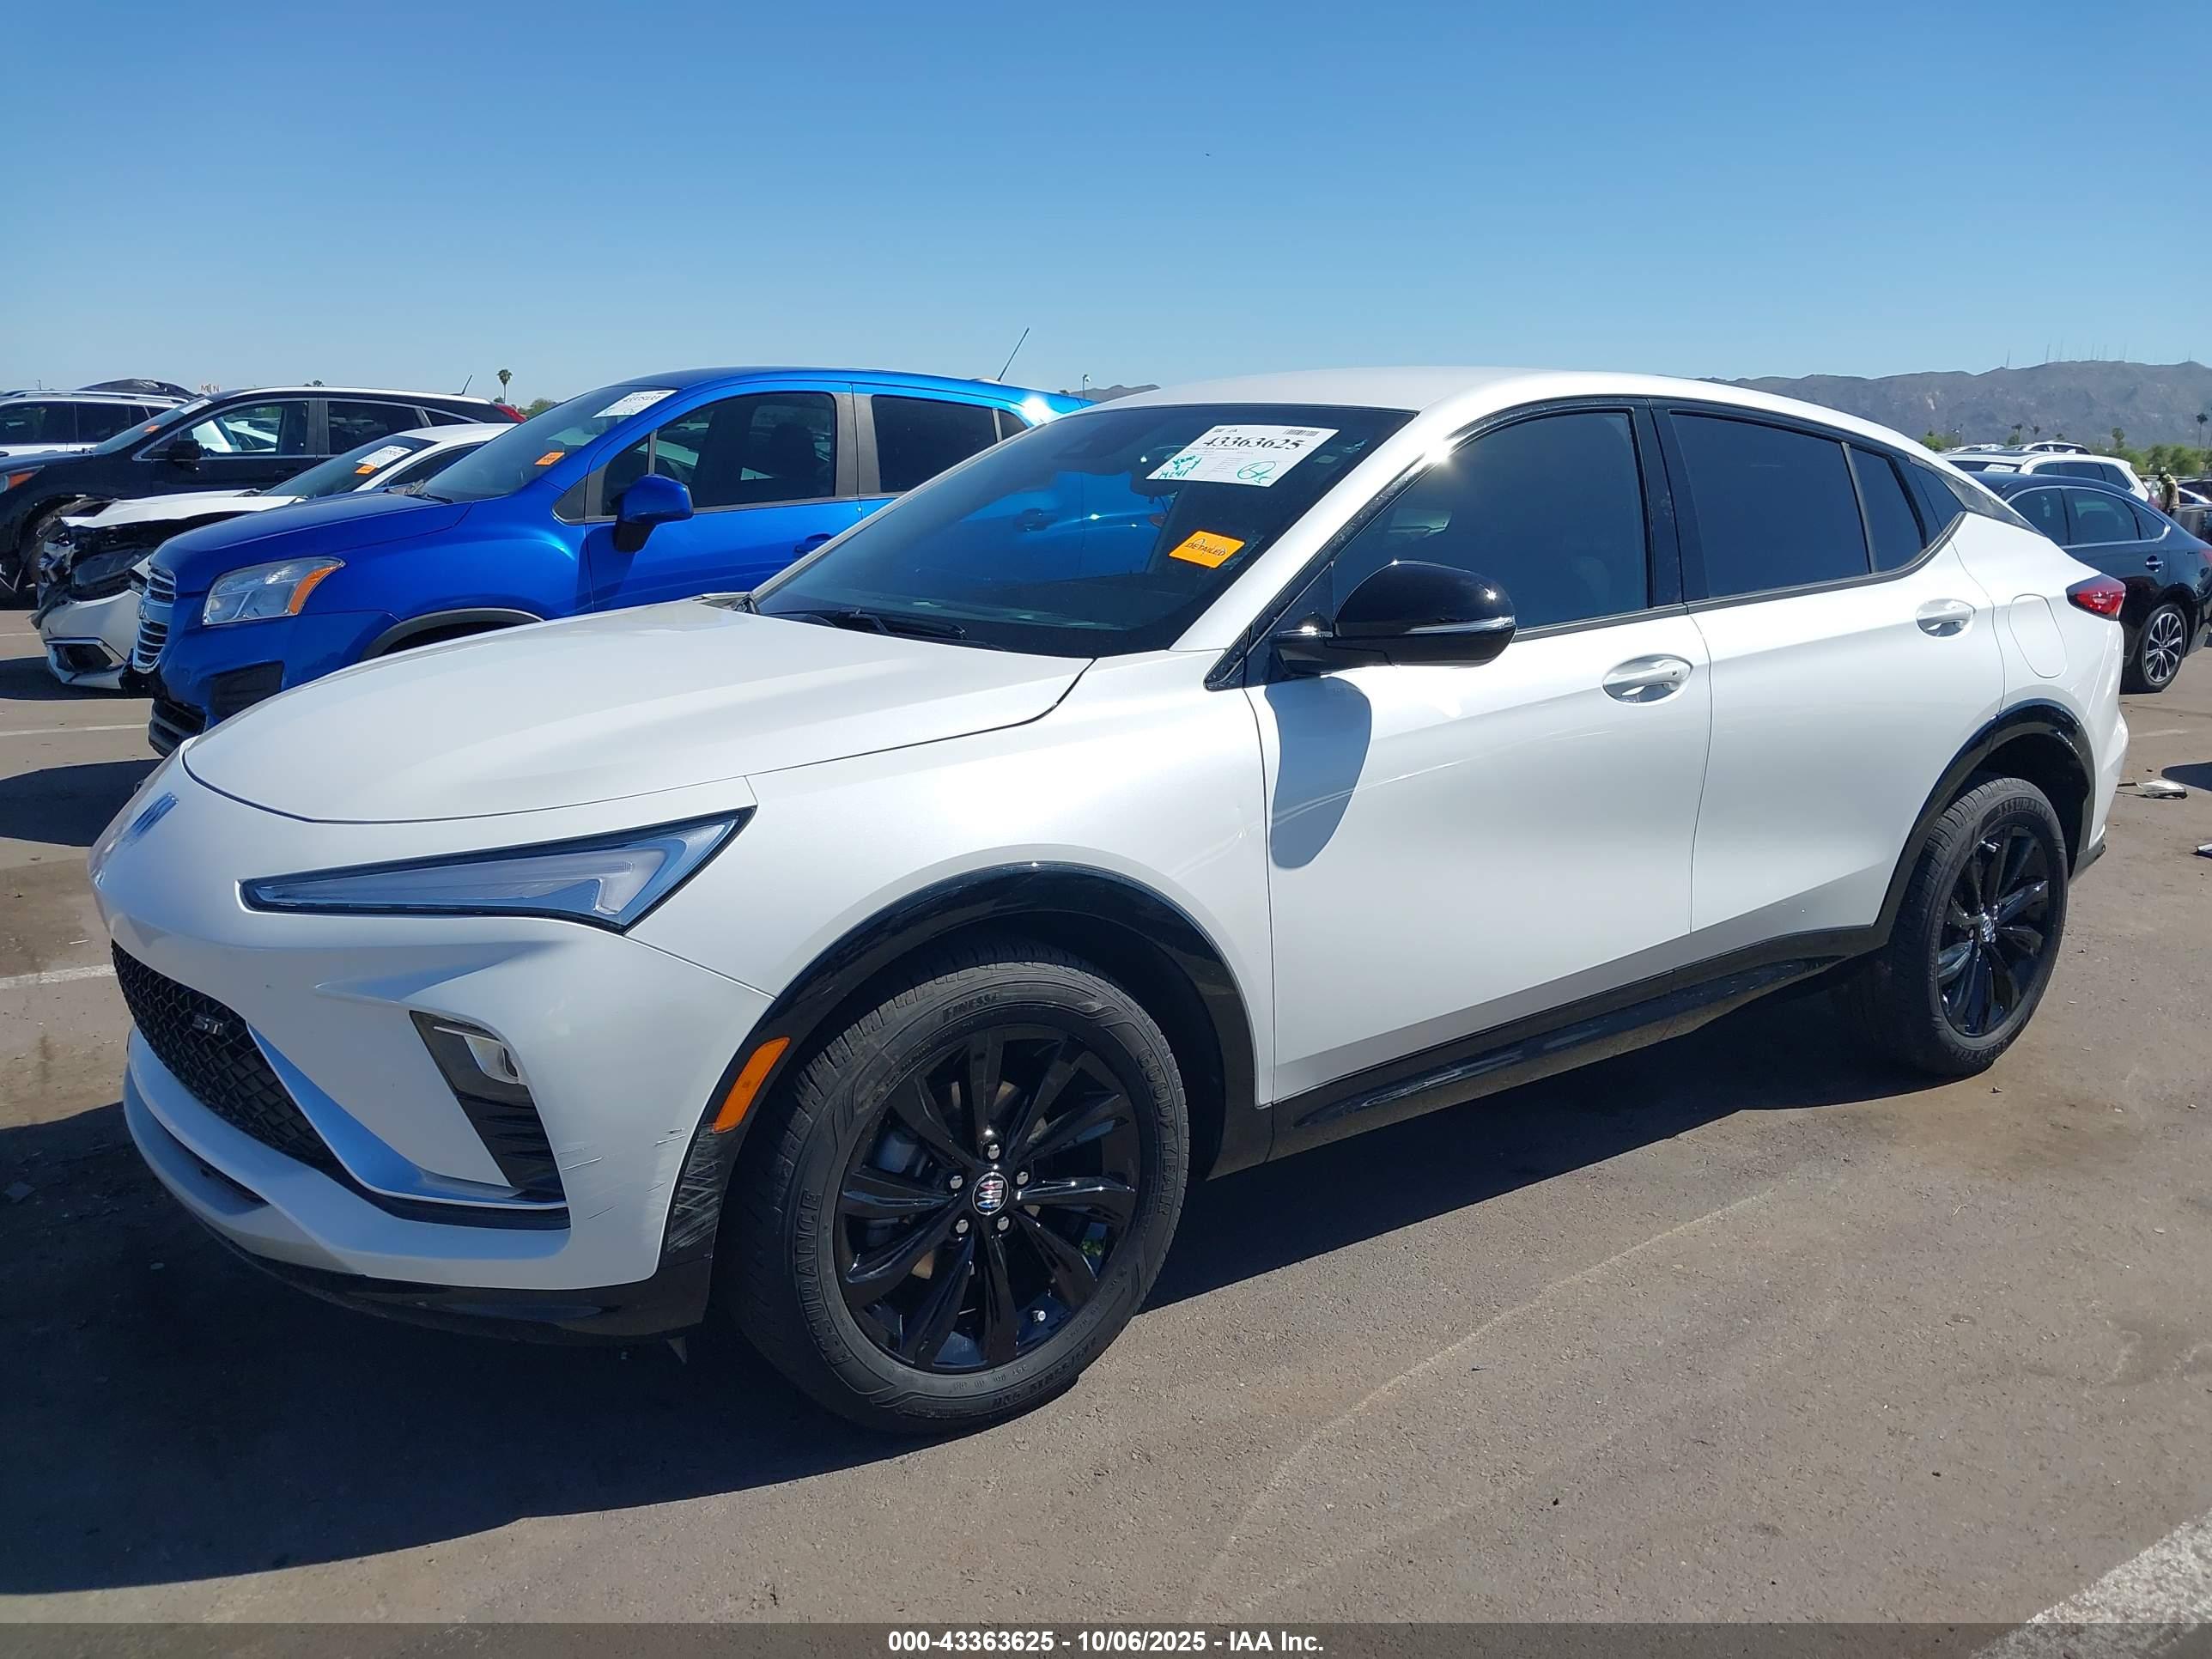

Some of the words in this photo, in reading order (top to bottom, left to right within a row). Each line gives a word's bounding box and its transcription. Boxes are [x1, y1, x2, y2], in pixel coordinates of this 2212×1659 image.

[1203, 435, 1306, 450] 43363625
[1185, 542, 1226, 556] DETAILED
[191, 1014, 223, 1036] ST
[1136, 1048, 1178, 1216] GOODYEAR
[796, 1188, 853, 1367] ASSURANCE
